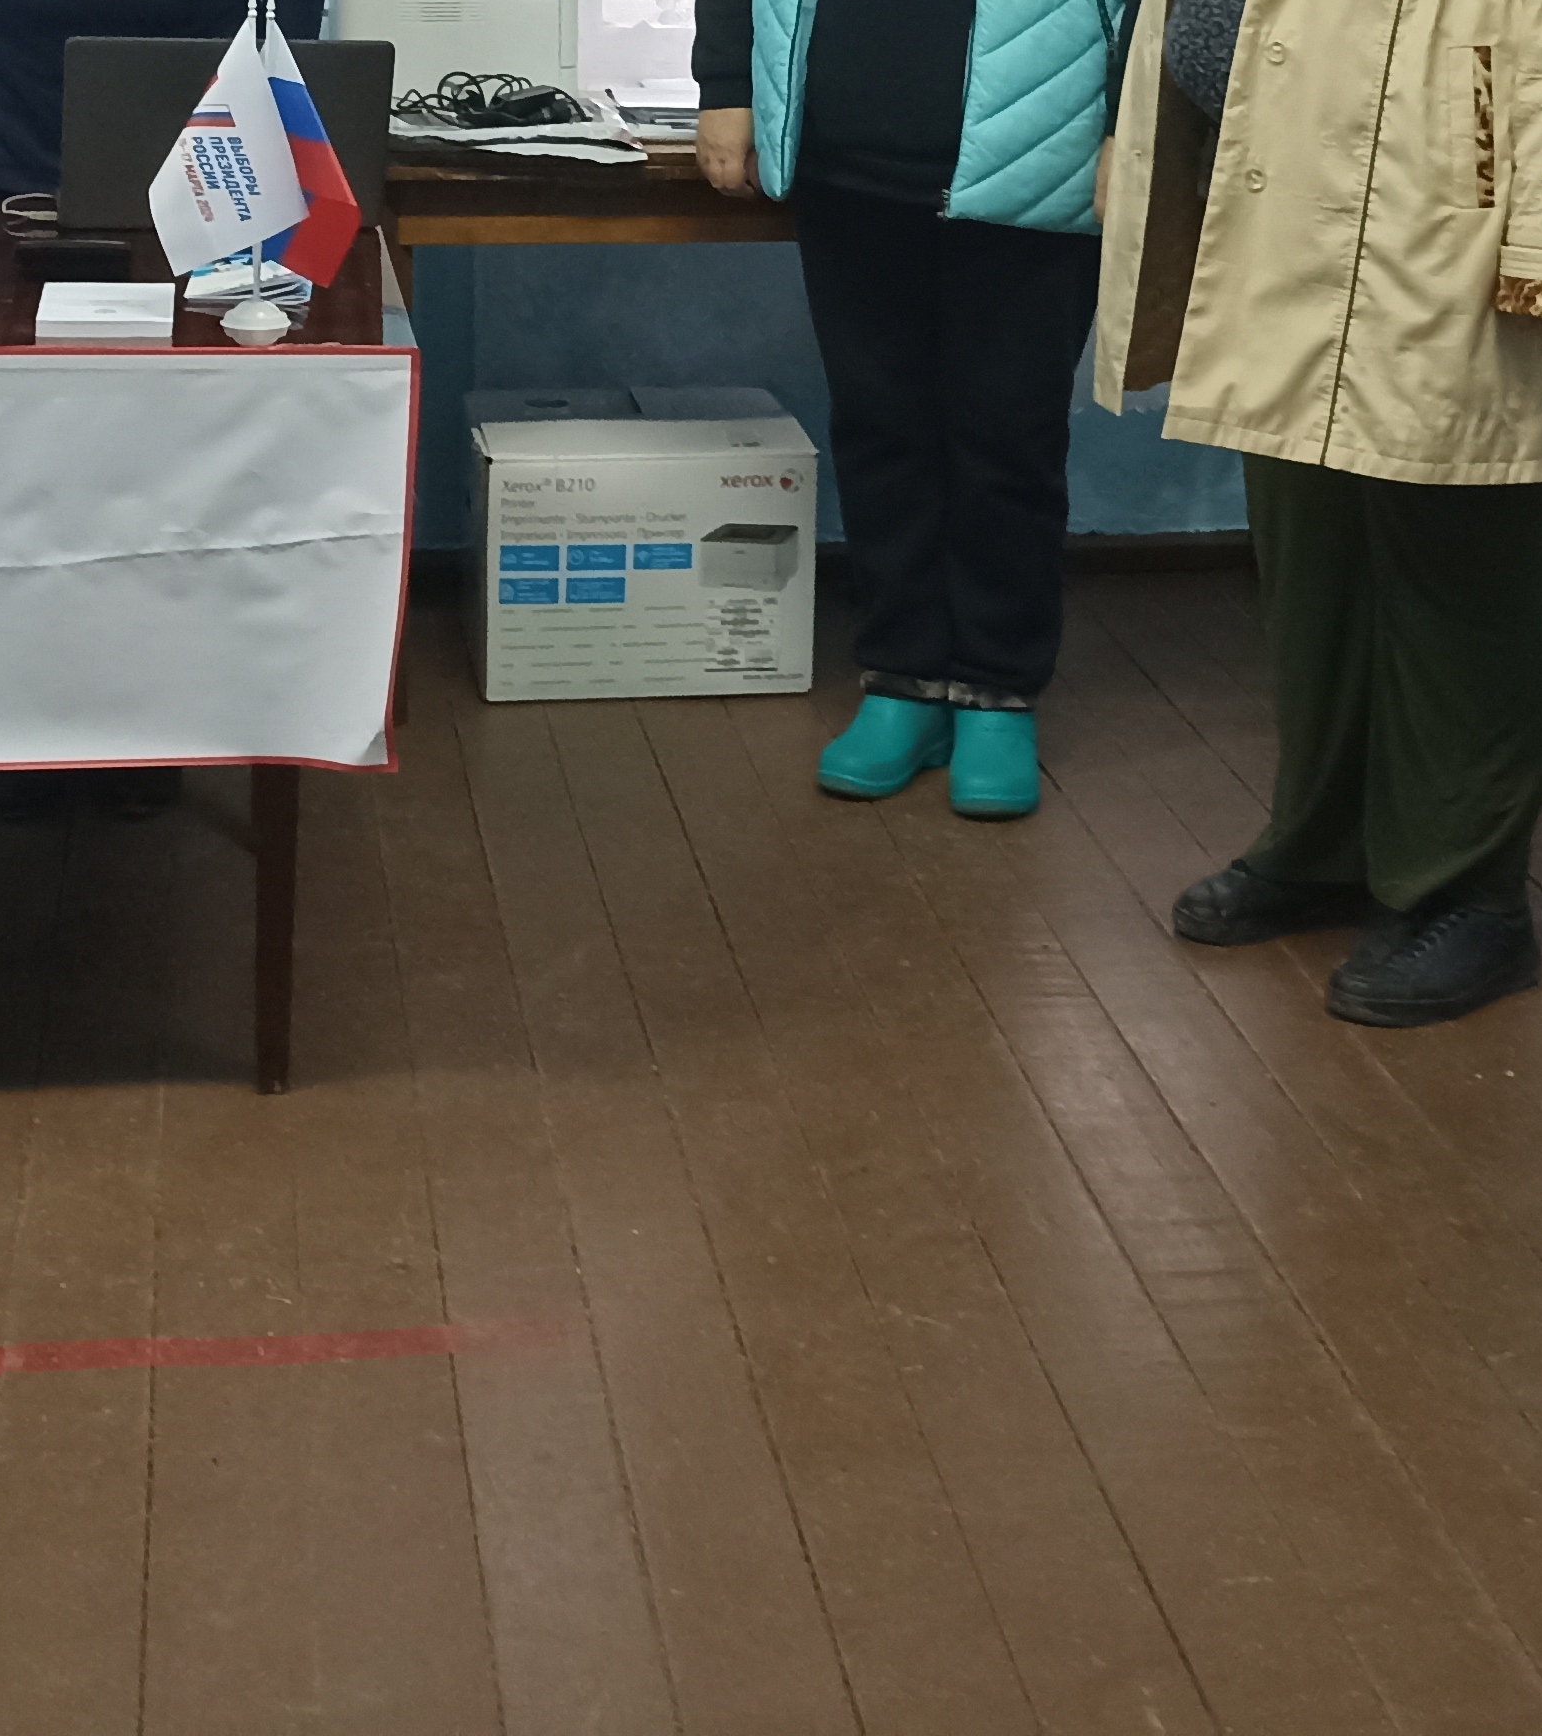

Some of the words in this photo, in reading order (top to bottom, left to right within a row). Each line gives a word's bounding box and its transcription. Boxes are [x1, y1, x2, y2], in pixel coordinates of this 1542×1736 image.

[190, 136, 221, 190] РОССИИ
[208, 136, 253, 222] ПРЕЗИДЕНТА
[226, 136, 262, 196] ВЫБОРЫ
[555, 477, 596, 493] B210
[719, 474, 775, 489] xerox
